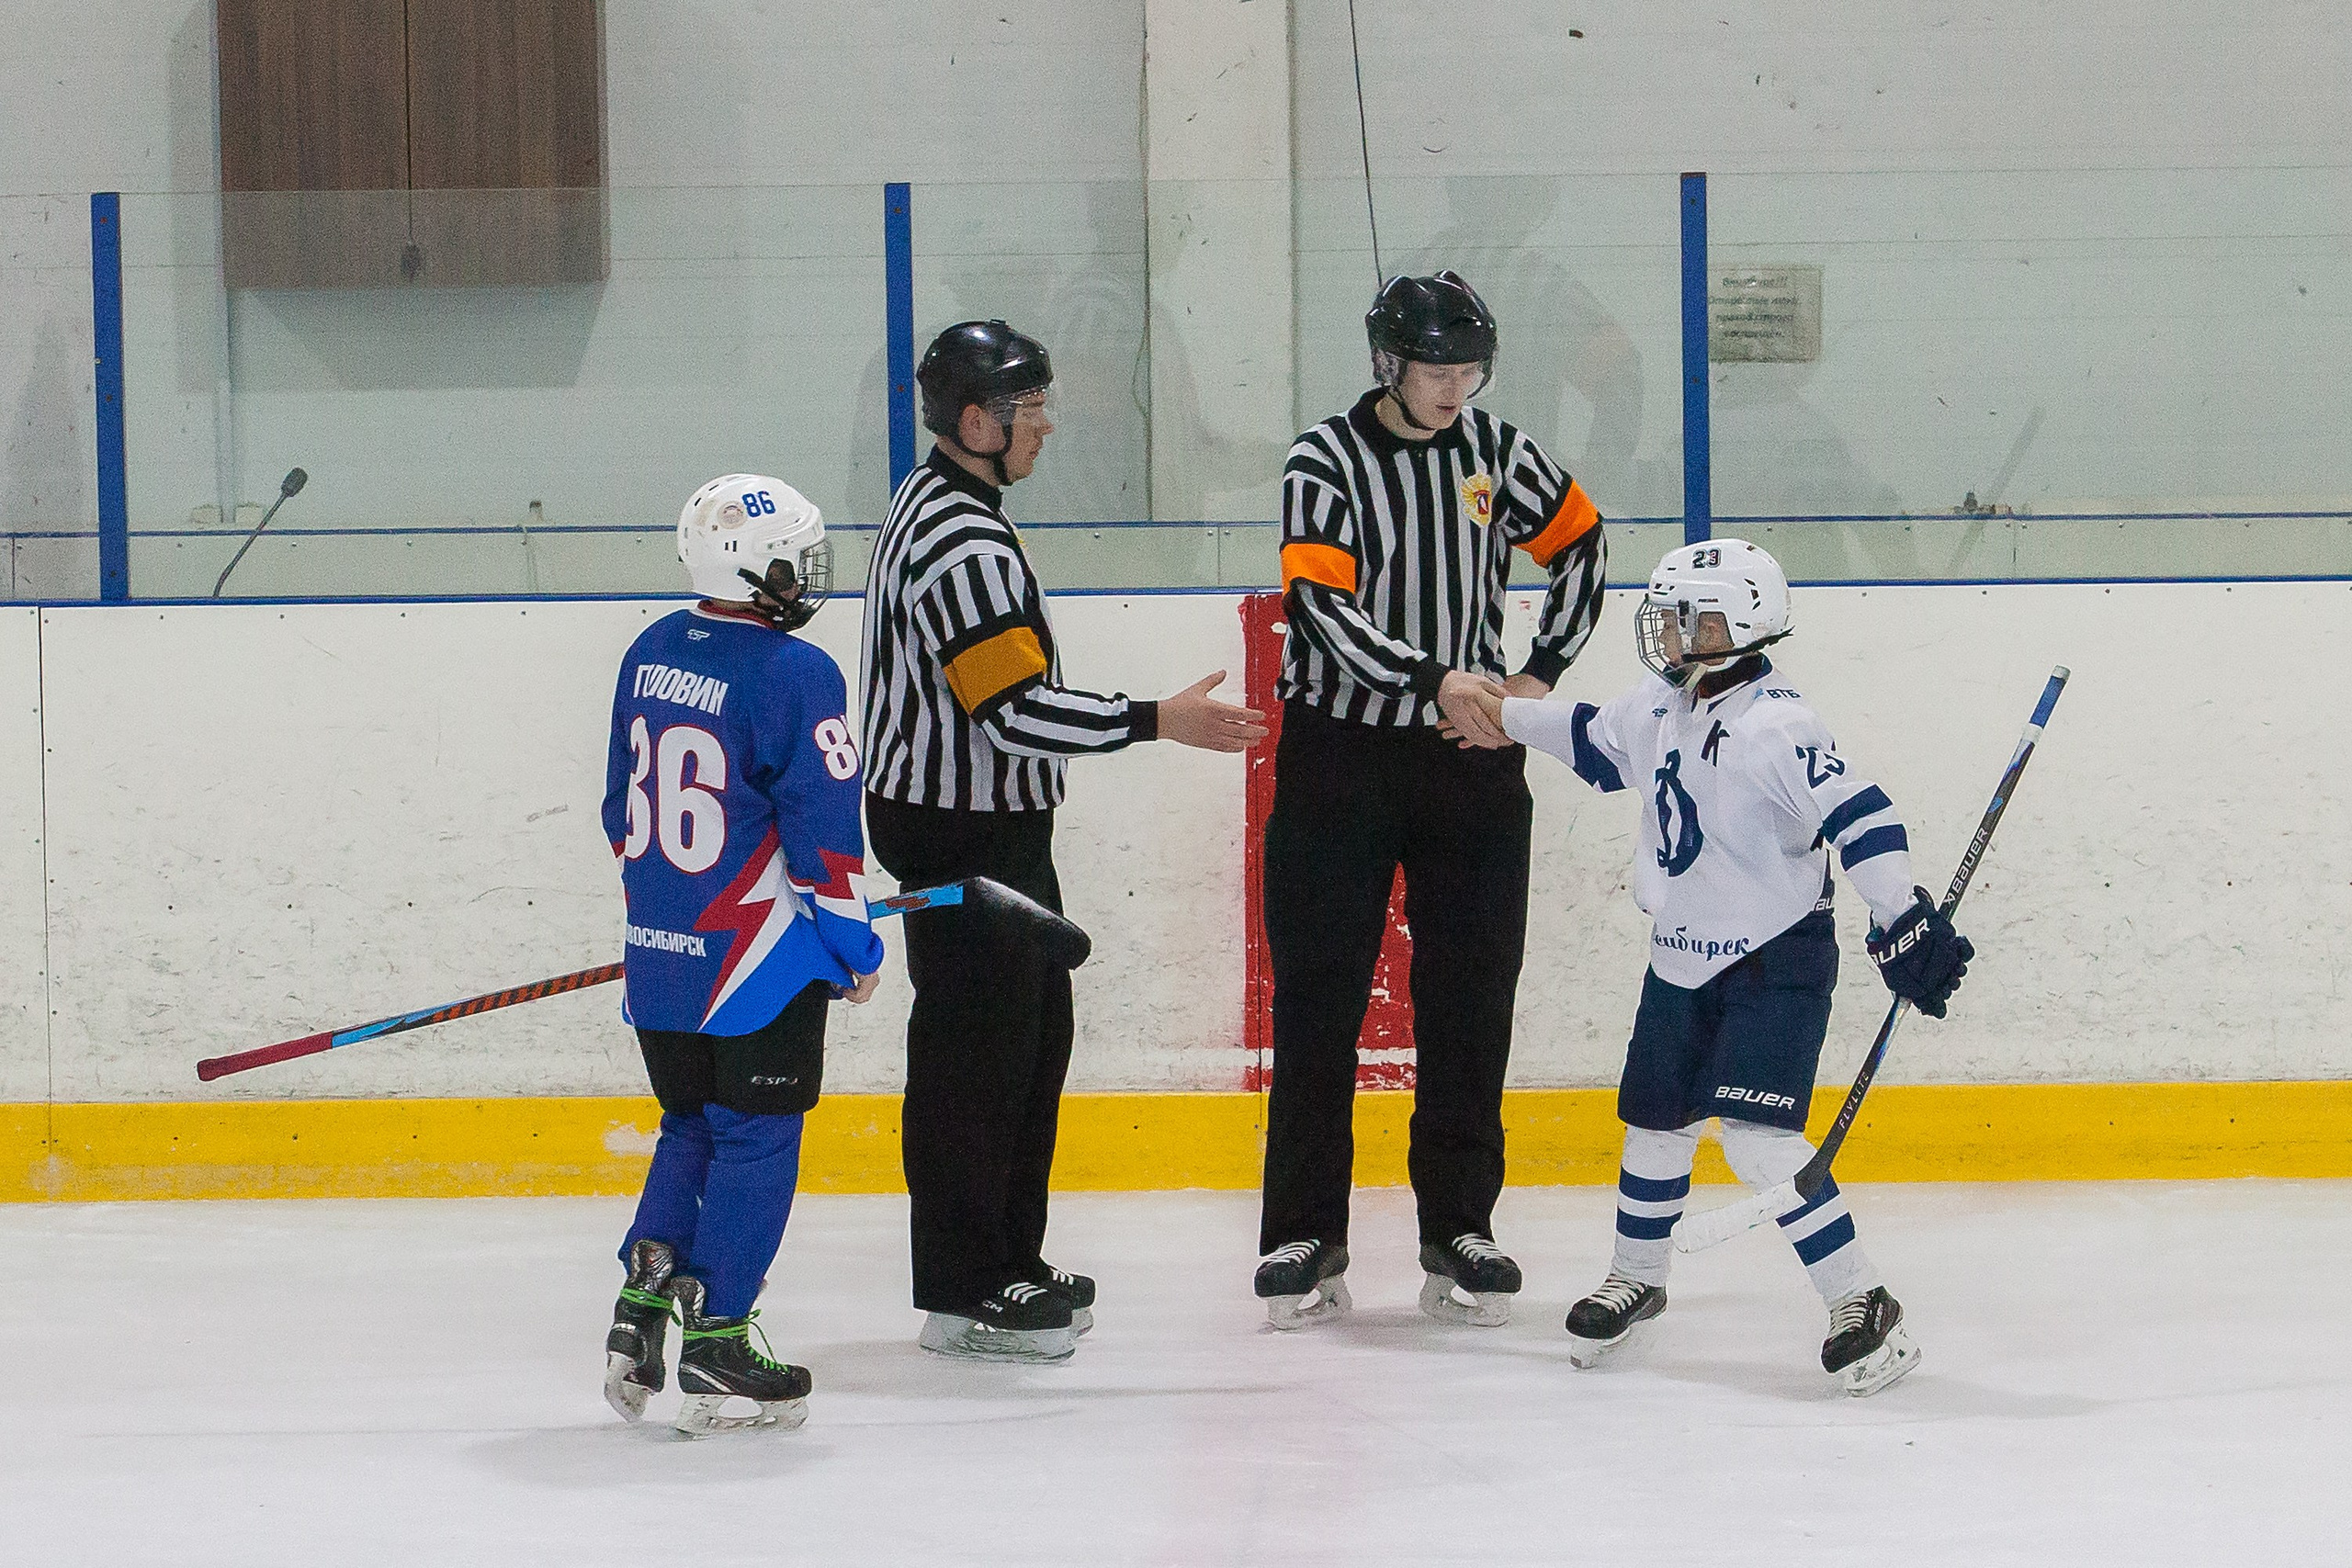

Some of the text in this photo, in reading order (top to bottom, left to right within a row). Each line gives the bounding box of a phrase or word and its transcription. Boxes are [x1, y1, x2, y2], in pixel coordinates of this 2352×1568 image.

[741, 490, 776, 518] 86
[1692, 547, 1722, 569] 23
[1951, 827, 1989, 894] BAUER
[1715, 1086, 1796, 1111] BAUER
[1838, 1071, 1870, 1130] FLYLITE
